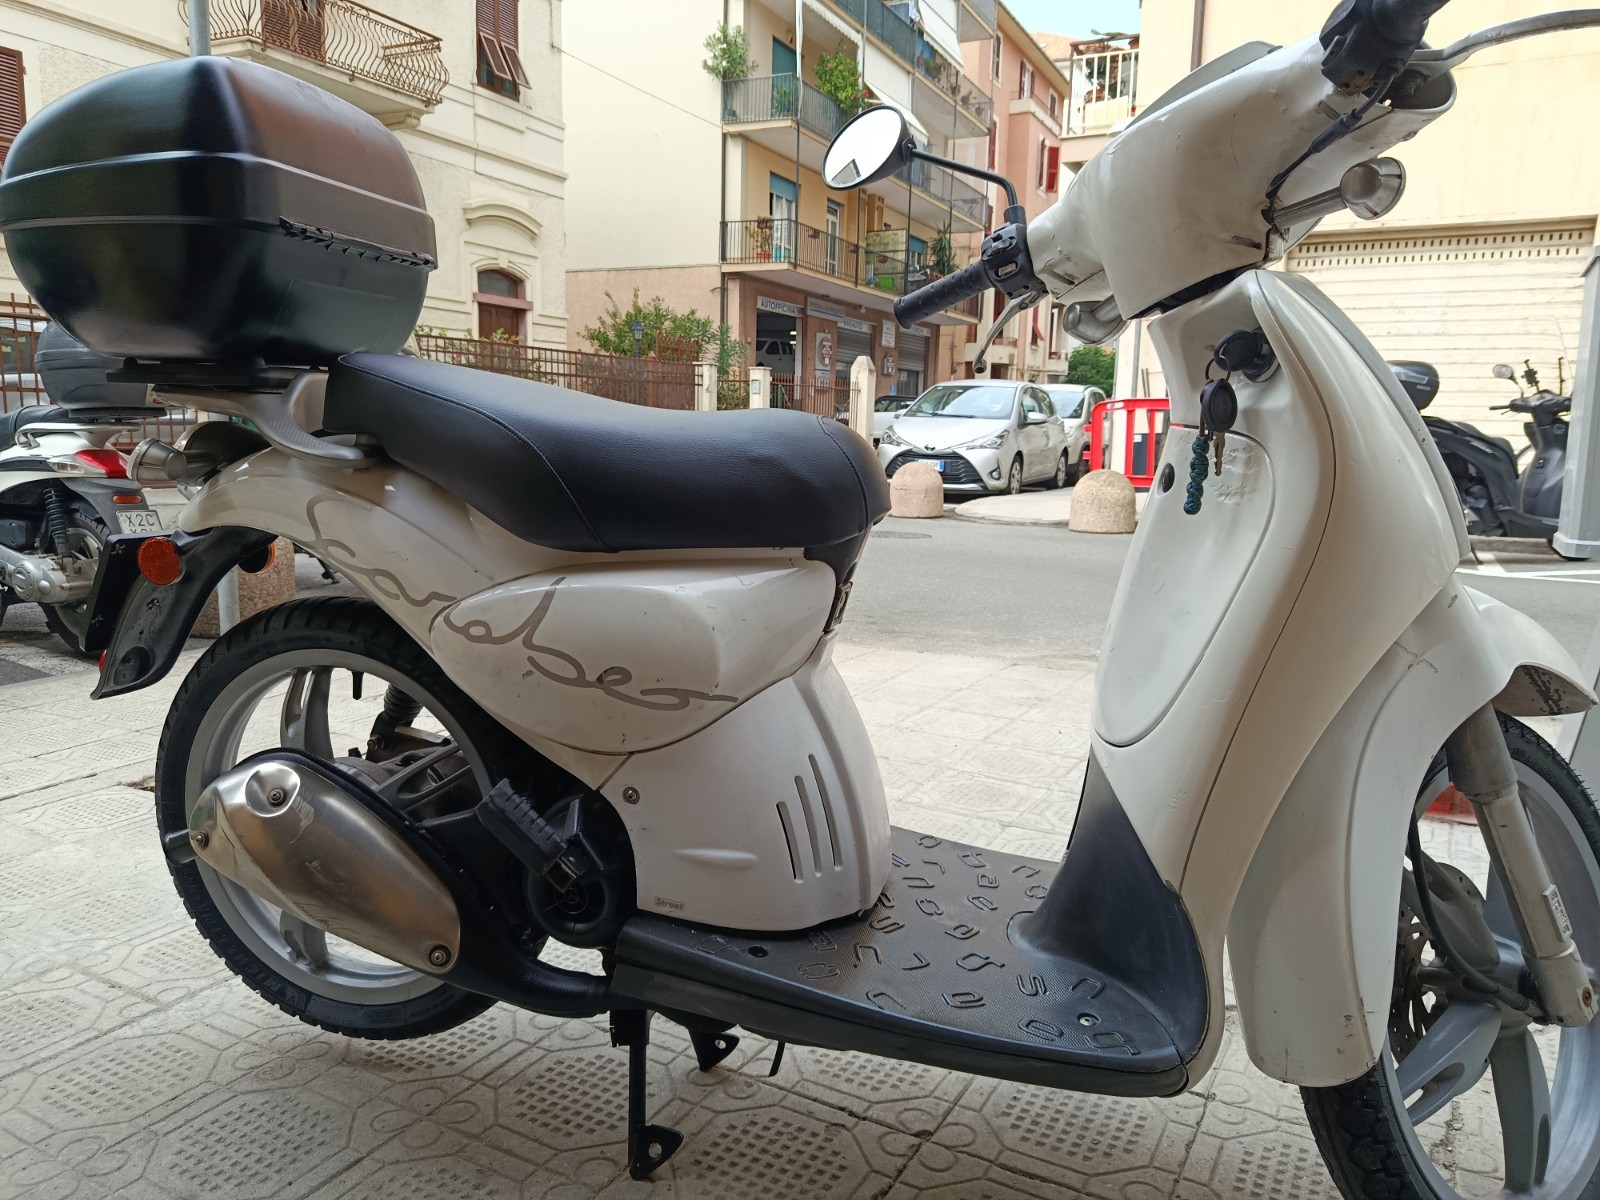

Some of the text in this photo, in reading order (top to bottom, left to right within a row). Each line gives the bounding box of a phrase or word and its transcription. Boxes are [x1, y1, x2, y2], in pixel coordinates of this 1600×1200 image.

[760, 299, 796, 315] AUTOFFICINA
[125, 513, 155, 527] X2C
[655, 896, 686, 911] Street
